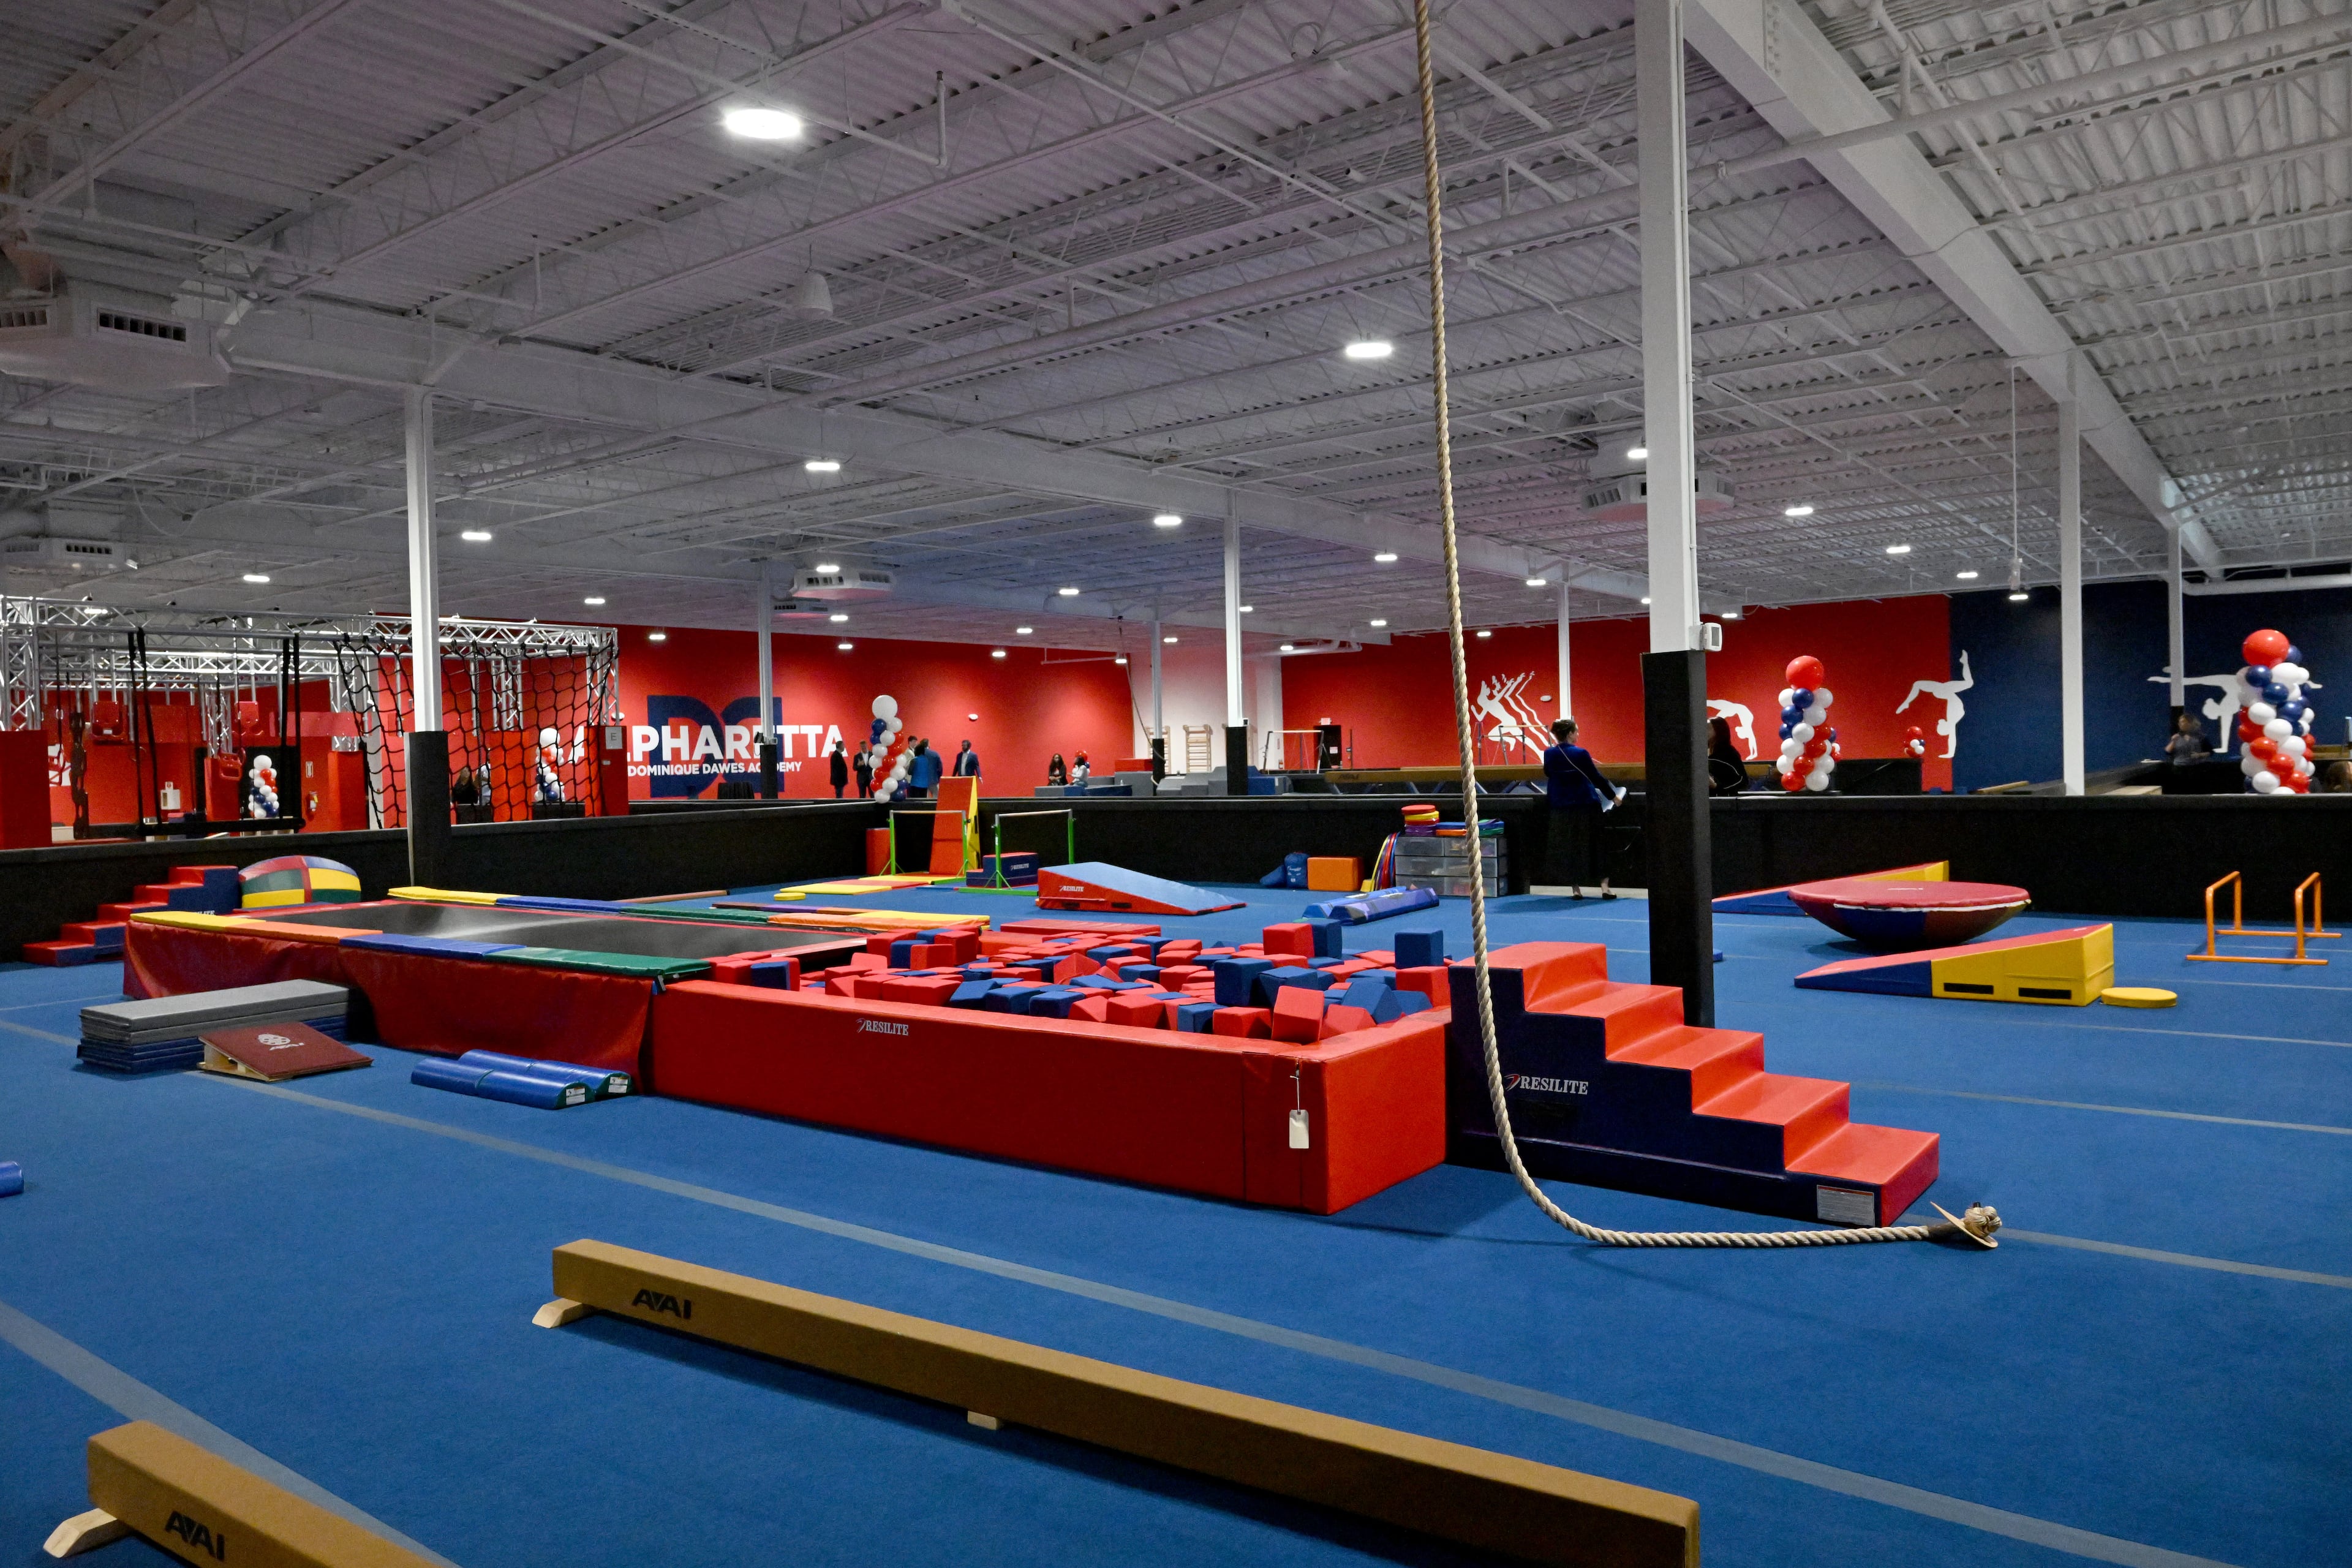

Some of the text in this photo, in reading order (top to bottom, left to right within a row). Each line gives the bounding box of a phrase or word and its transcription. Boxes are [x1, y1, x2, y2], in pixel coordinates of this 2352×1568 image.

[627, 764, 699, 777] DOMINIQUE
[703, 762, 745, 774] DAWES
[865, 1020, 909, 1036] RESILITE
[1520, 1076, 1589, 1095] RESILITE
